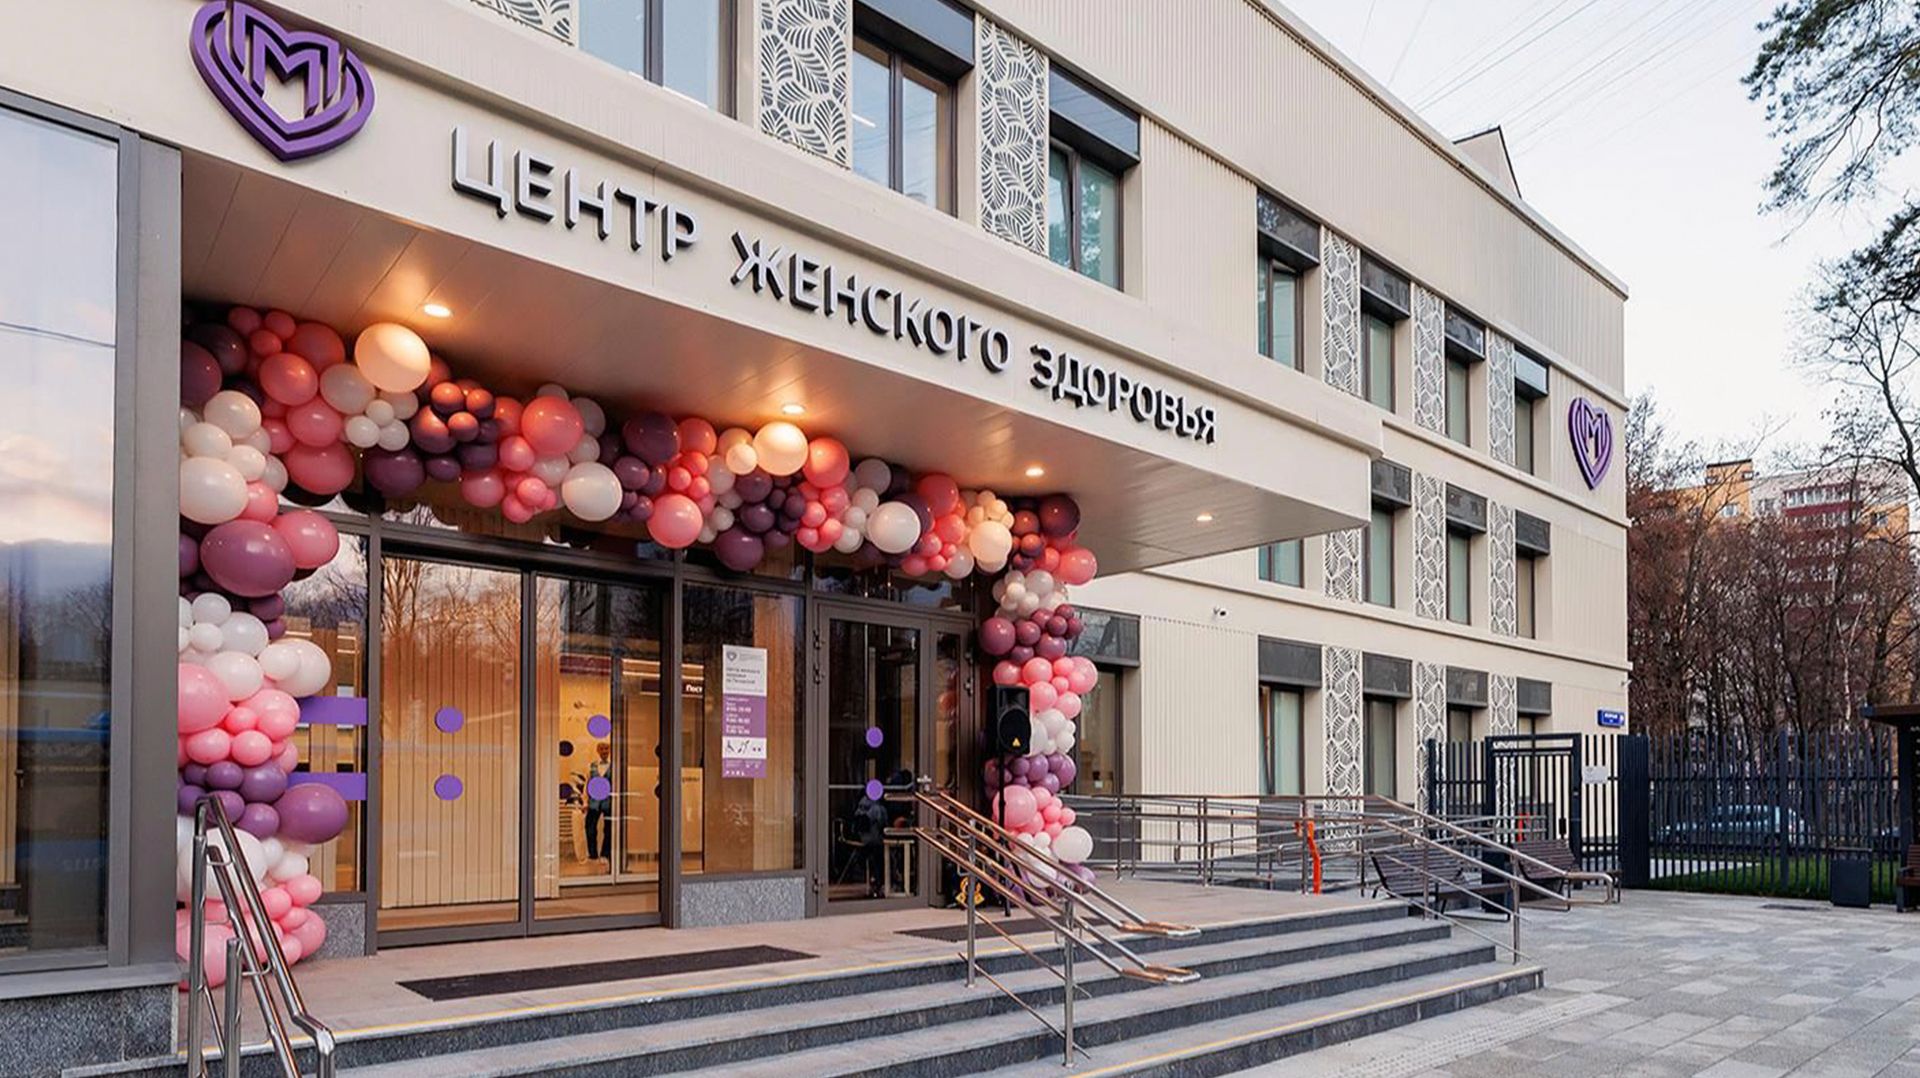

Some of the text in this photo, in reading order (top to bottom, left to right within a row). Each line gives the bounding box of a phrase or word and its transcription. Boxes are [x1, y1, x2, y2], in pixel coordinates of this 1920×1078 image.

[451, 125, 1219, 445] ЦЕНТР ЖЕНСКОГО ЗДОРОВЬЯ
